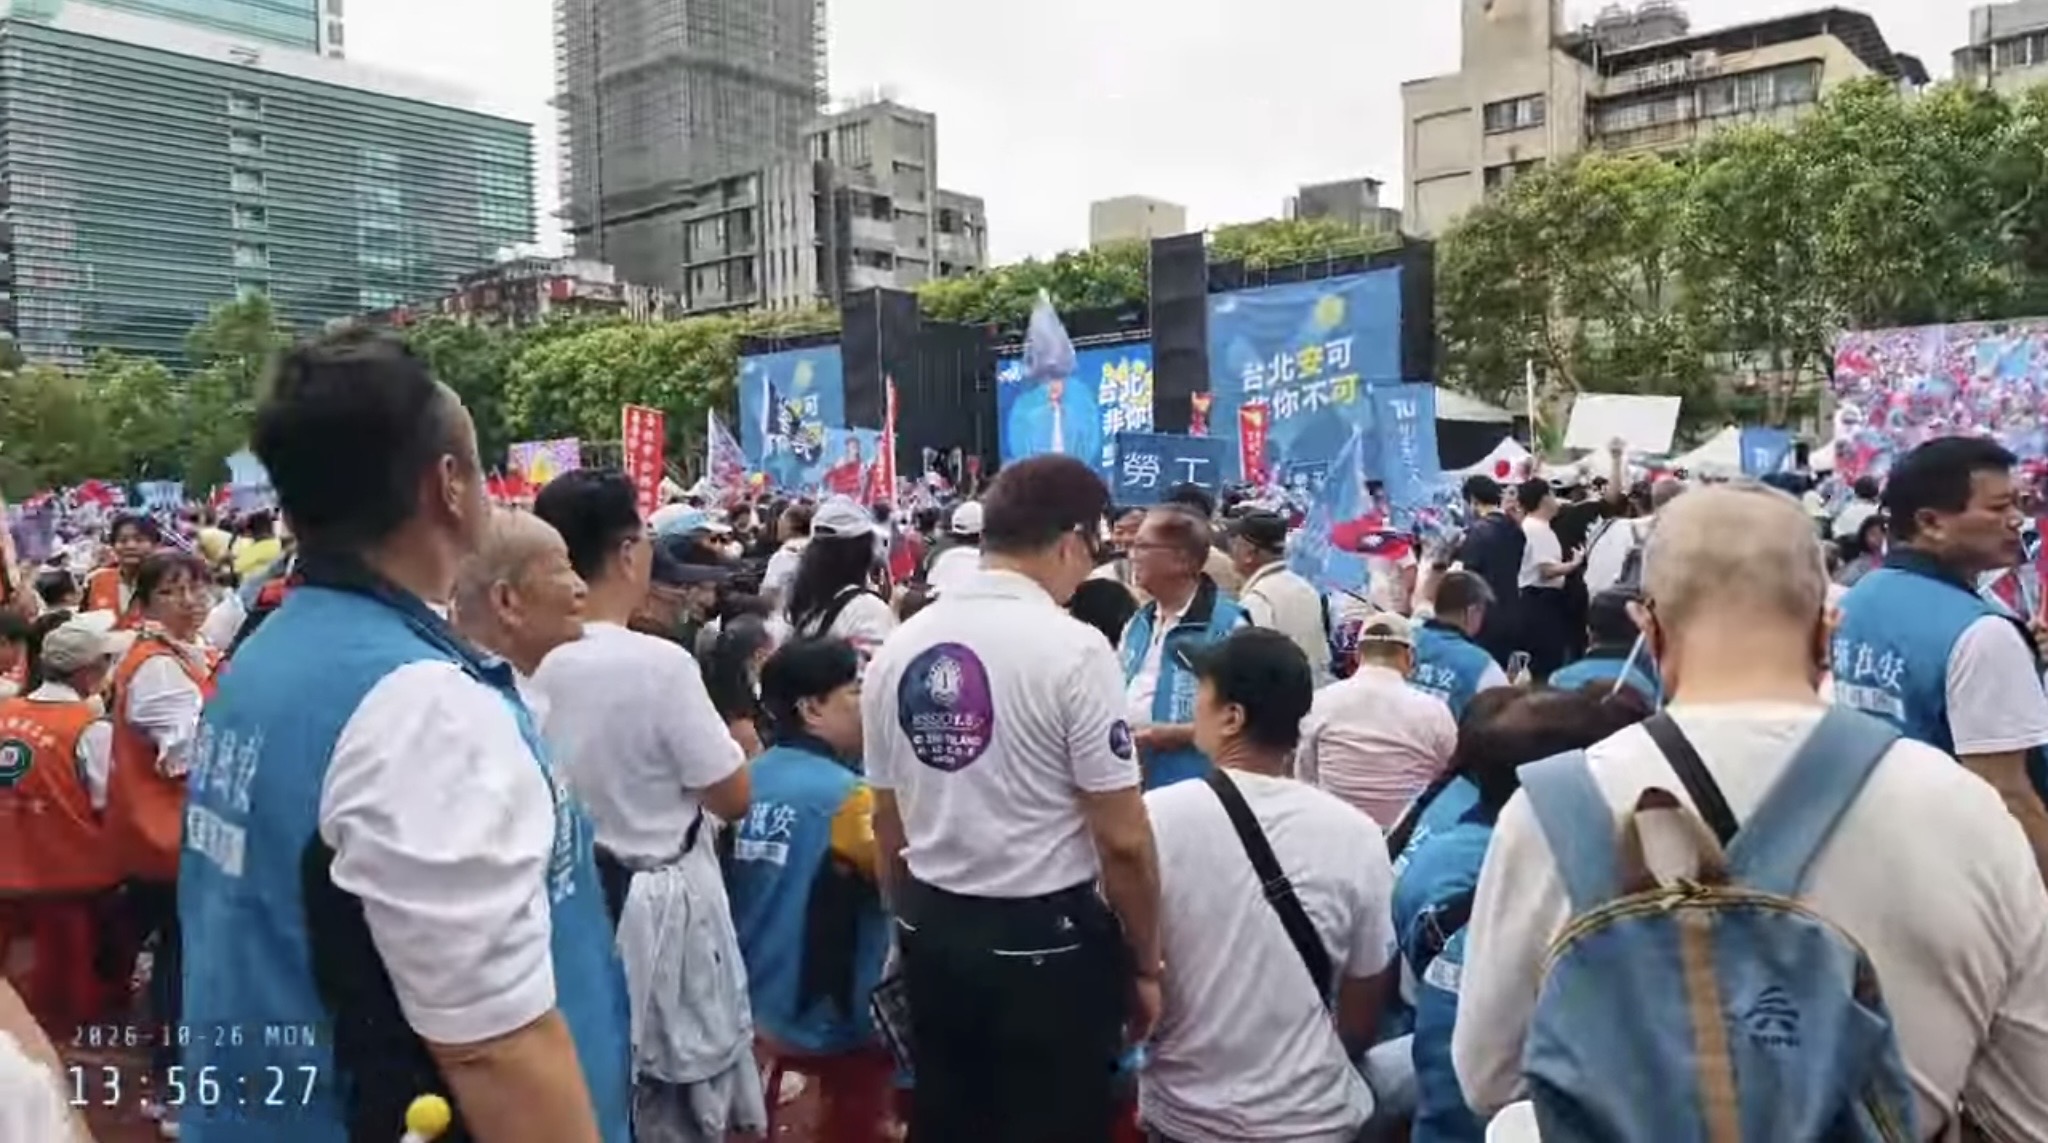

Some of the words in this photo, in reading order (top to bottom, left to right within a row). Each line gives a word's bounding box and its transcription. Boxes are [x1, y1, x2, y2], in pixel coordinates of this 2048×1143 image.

[1241, 336, 1353, 394] 台北安可
[1246, 374, 1360, 421] 你不可
[1122, 452, 1212, 490] 勞工
